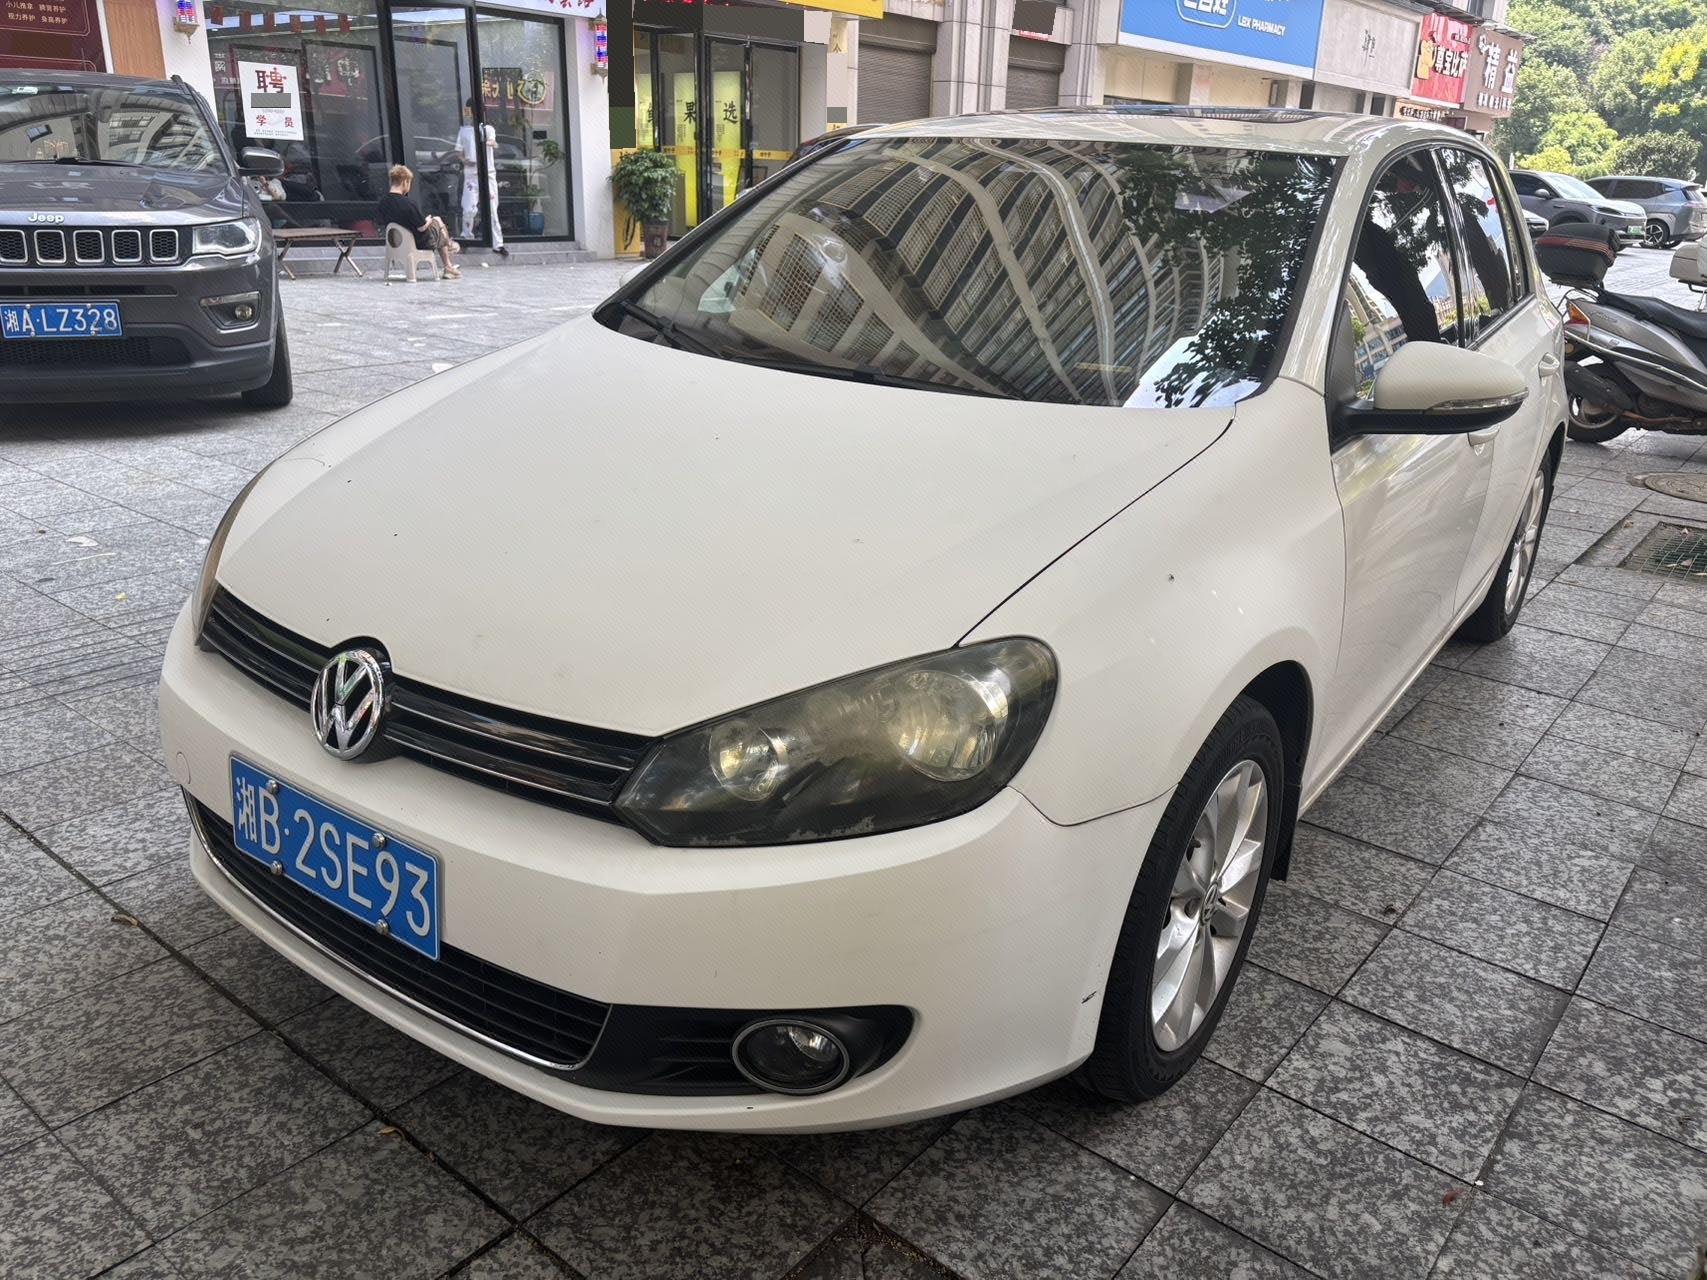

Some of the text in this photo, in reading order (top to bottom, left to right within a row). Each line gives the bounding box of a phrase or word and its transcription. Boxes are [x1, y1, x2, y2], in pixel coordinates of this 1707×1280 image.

[6, 1, 34, 10] 小儿推拿
[41, 15, 68, 24] 身高养护
[1237, 14, 1286, 36] LBX PHARMACY
[1435, 45, 1468, 78] 尊宝比萨
[1484, 42, 1519, 94] 精益
[255, 67, 287, 93] 聘
[723, 100, 739, 124] 选
[27, 212, 65, 224] Jeep
